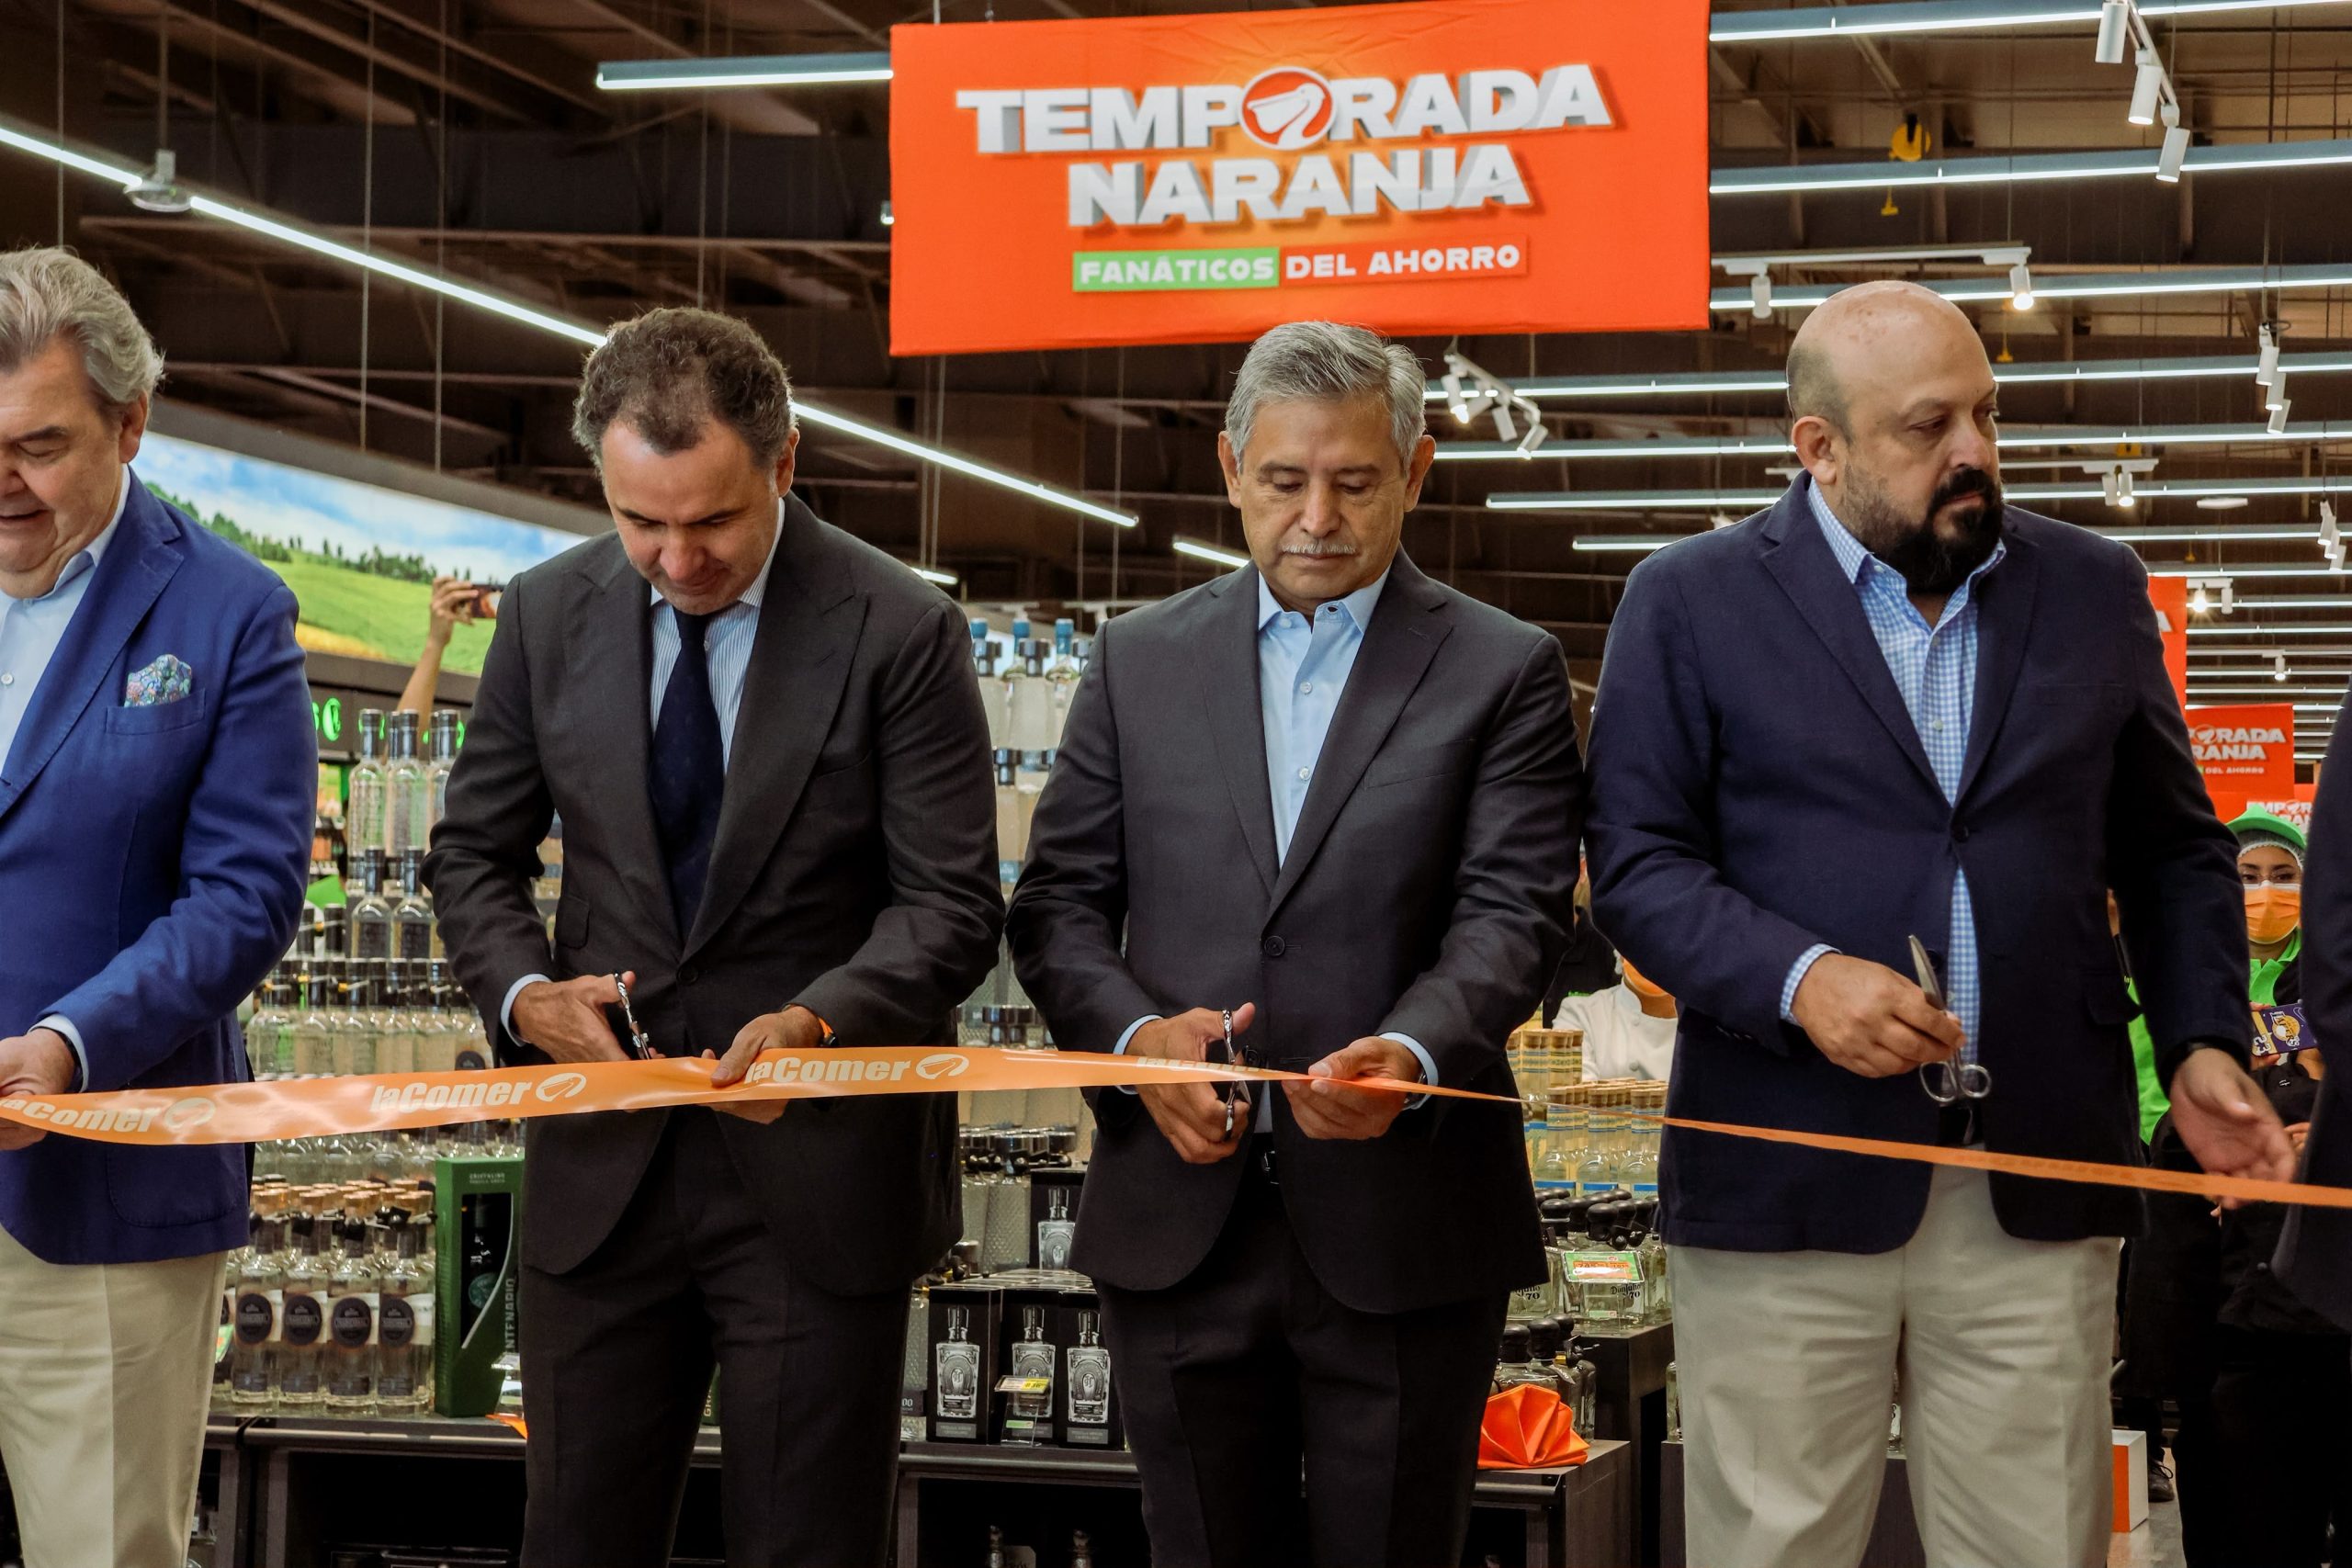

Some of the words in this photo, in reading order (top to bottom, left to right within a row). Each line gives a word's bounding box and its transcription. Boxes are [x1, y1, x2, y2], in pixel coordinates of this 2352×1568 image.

[1069, 144, 1532, 227] NARANJA
[1080, 255, 1274, 285] FANÁTICOS
[1286, 254, 1357, 279] DEL
[1367, 244, 1521, 276] AHORRO
[2191, 744, 2267, 761] RANJA
[744, 1056, 910, 1085] laComer
[370, 1082, 533, 1113] laComer
[1629, 1291, 1641, 1299] 70
